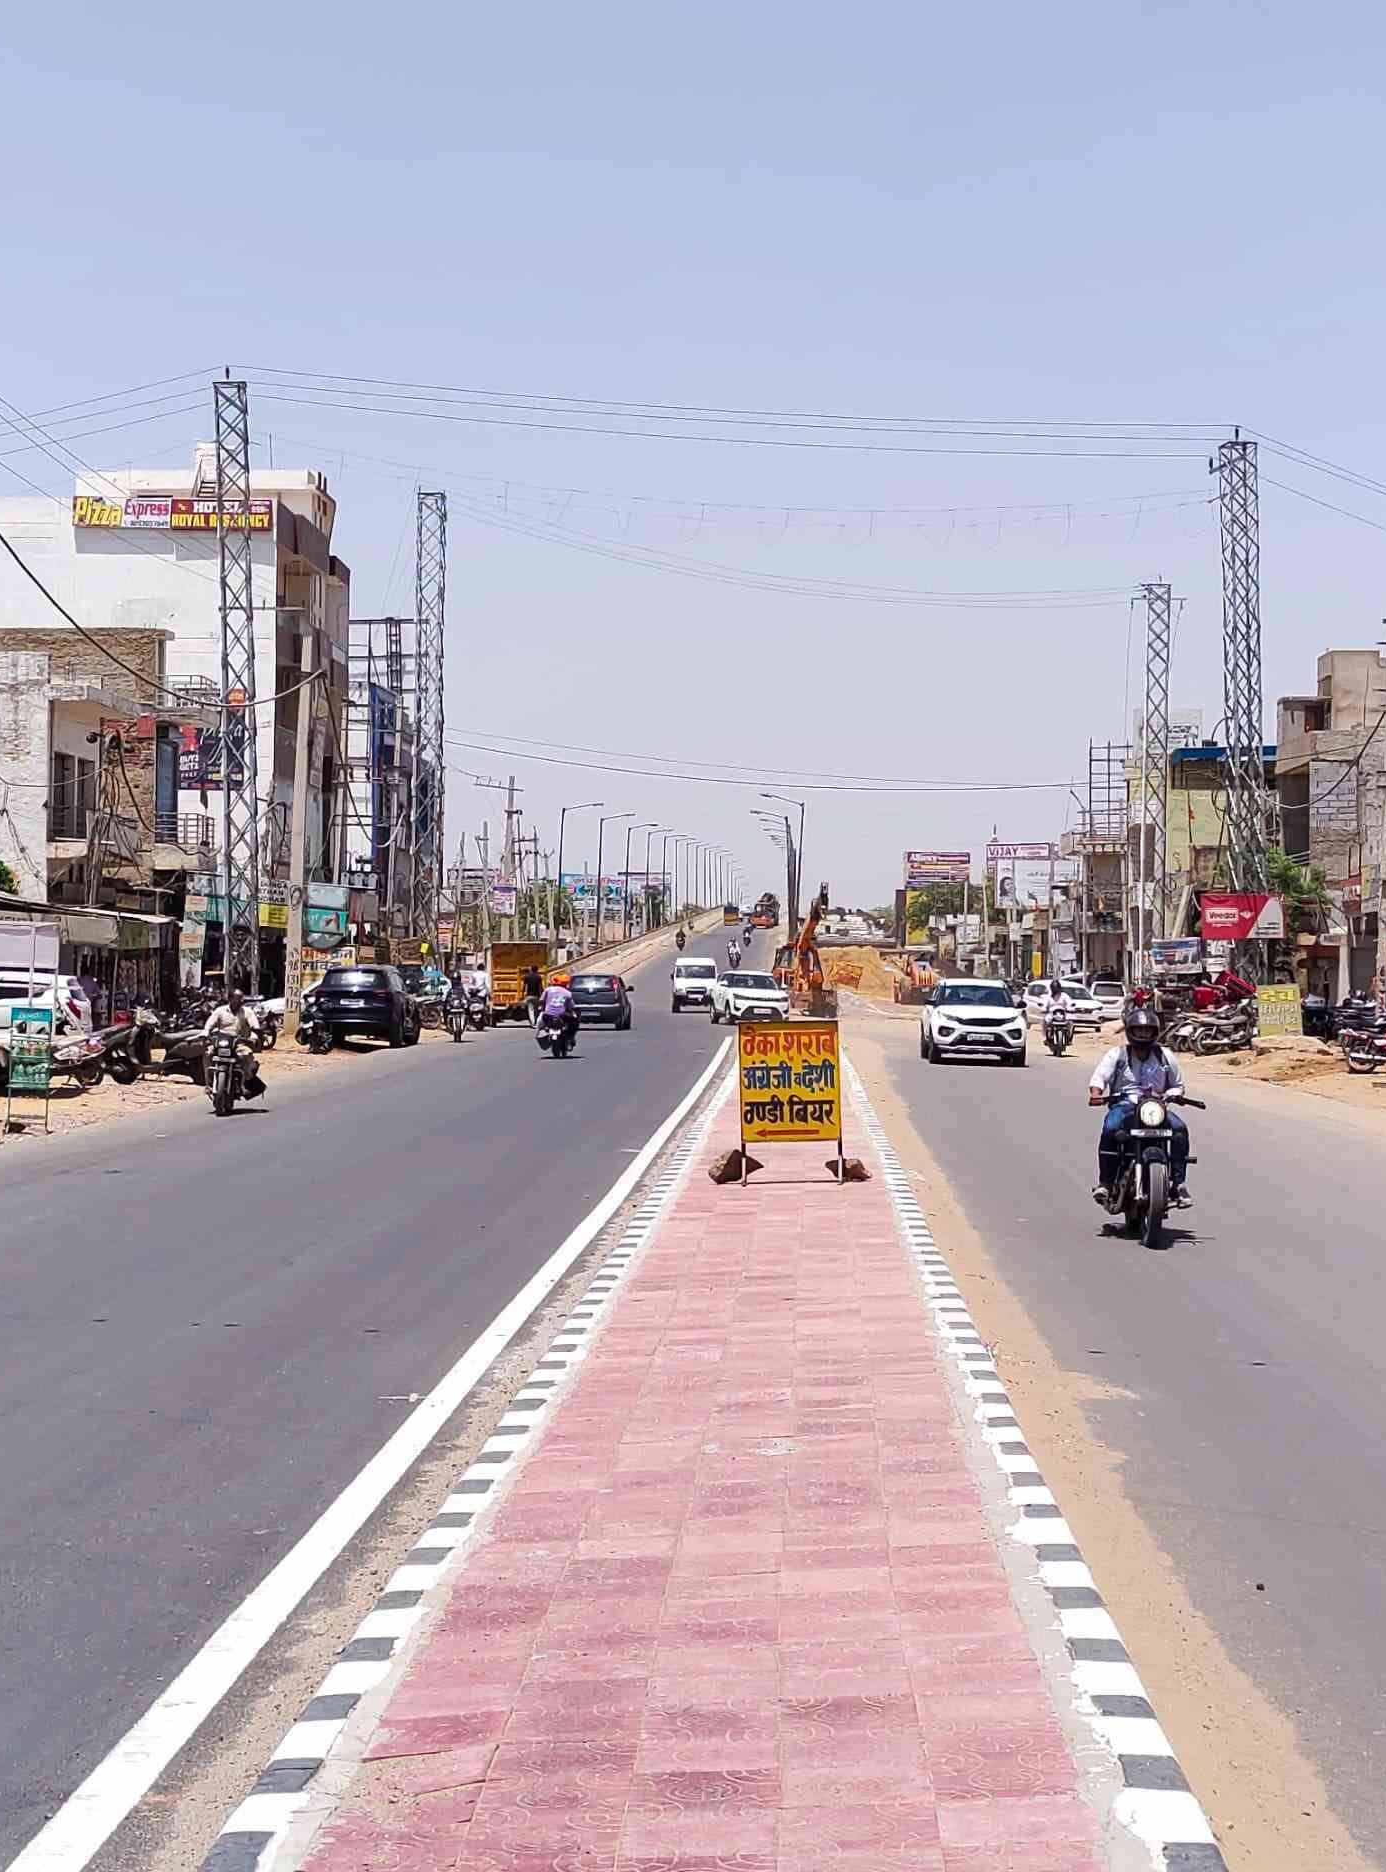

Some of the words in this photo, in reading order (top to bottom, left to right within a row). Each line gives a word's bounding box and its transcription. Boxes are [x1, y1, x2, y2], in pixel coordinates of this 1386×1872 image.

[74, 497, 121, 528] Pizza
[124, 499, 169, 519] Express
[172, 513, 205, 527] ROYAL
[988, 846, 1019, 857] VIJAY
[741, 1026, 782, 1057] ठेका
[742, 1060, 793, 1091] अंग्रेजी
[786, 1094, 836, 1126] बियर
